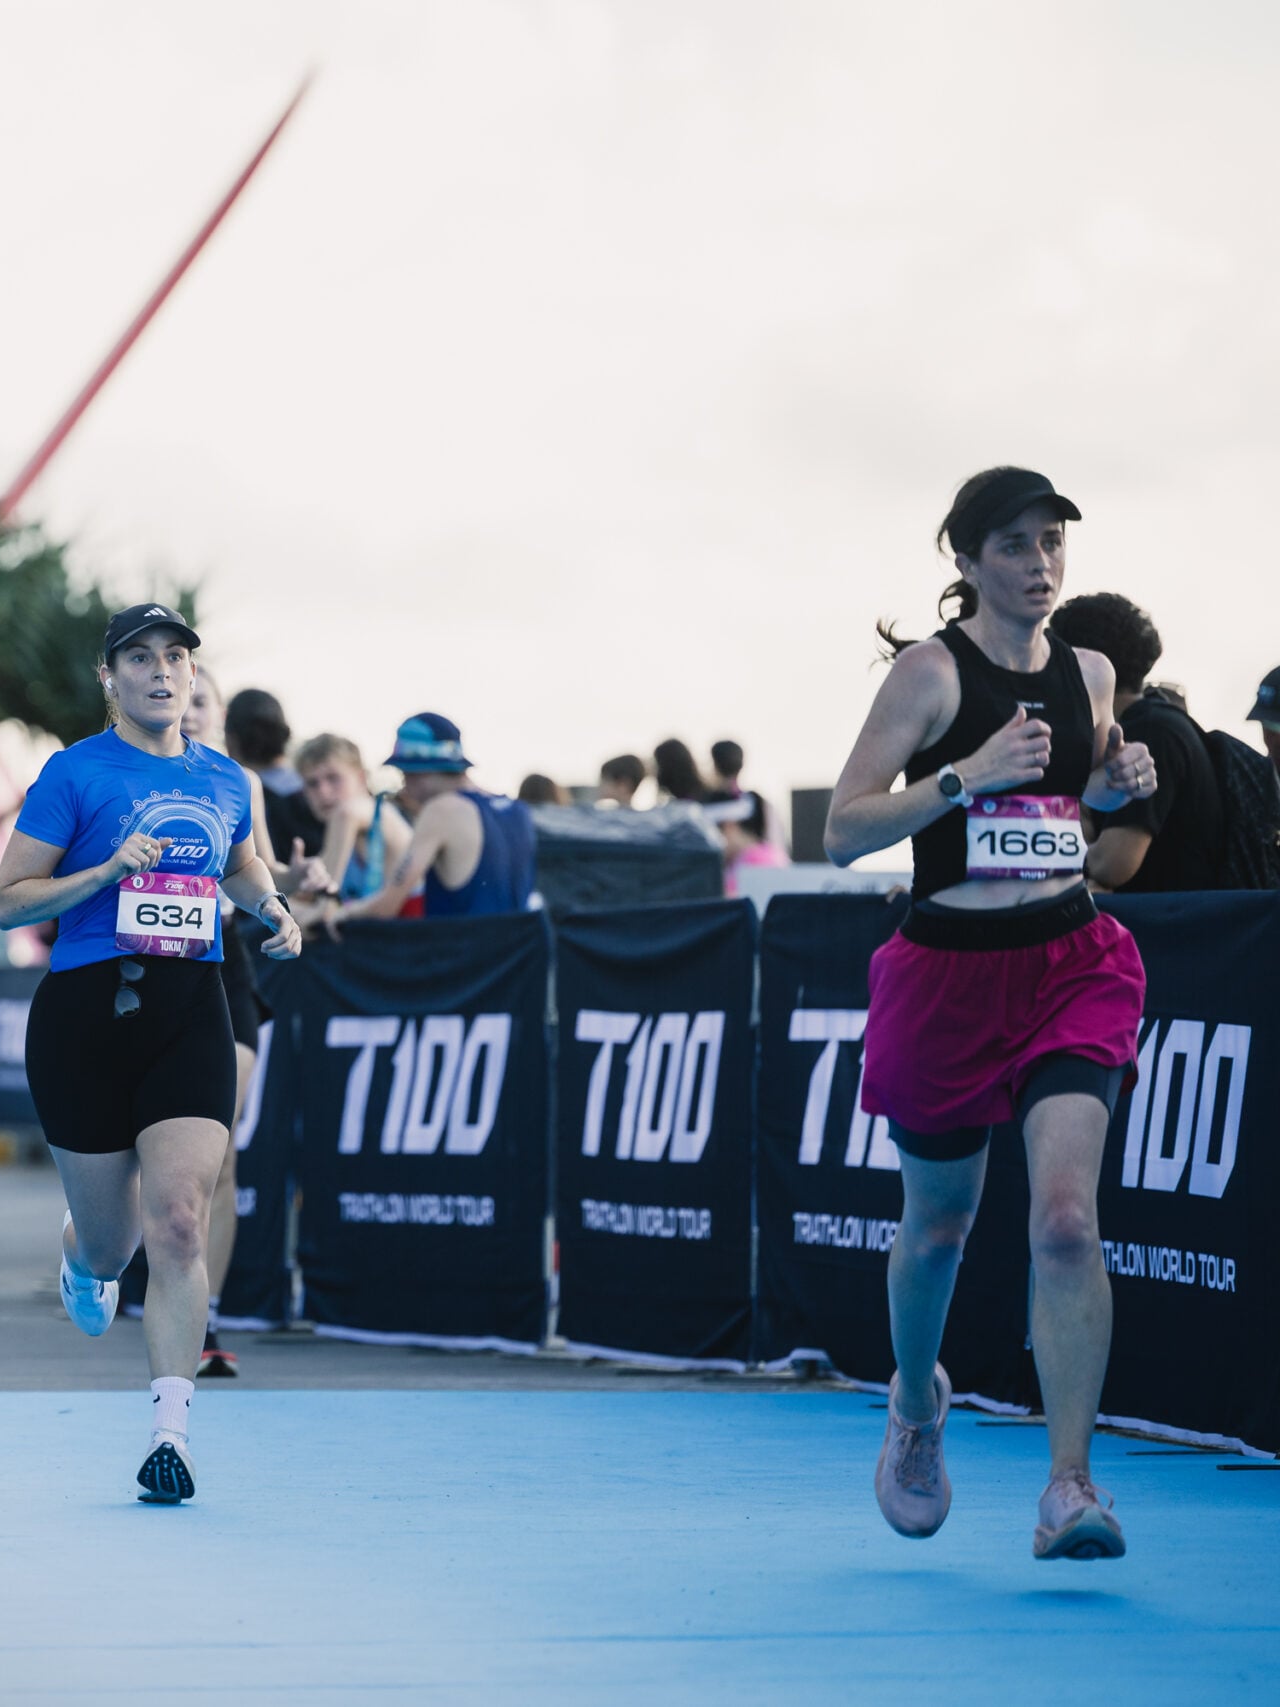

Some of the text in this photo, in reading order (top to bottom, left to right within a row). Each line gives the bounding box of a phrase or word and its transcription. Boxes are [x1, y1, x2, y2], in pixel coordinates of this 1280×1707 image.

[168, 844, 209, 858] 100
[977, 830, 1080, 856] 1663
[136, 903, 203, 929] 634
[160, 939, 182, 953] 10KM
[326, 1014, 512, 1155] T100
[575, 1009, 726, 1164] T100
[1122, 1016, 1252, 1199] 100
[793, 1211, 898, 1252] TRIATHLON WOR
[1100, 1240, 1236, 1292] THLON WORLD TOUR
